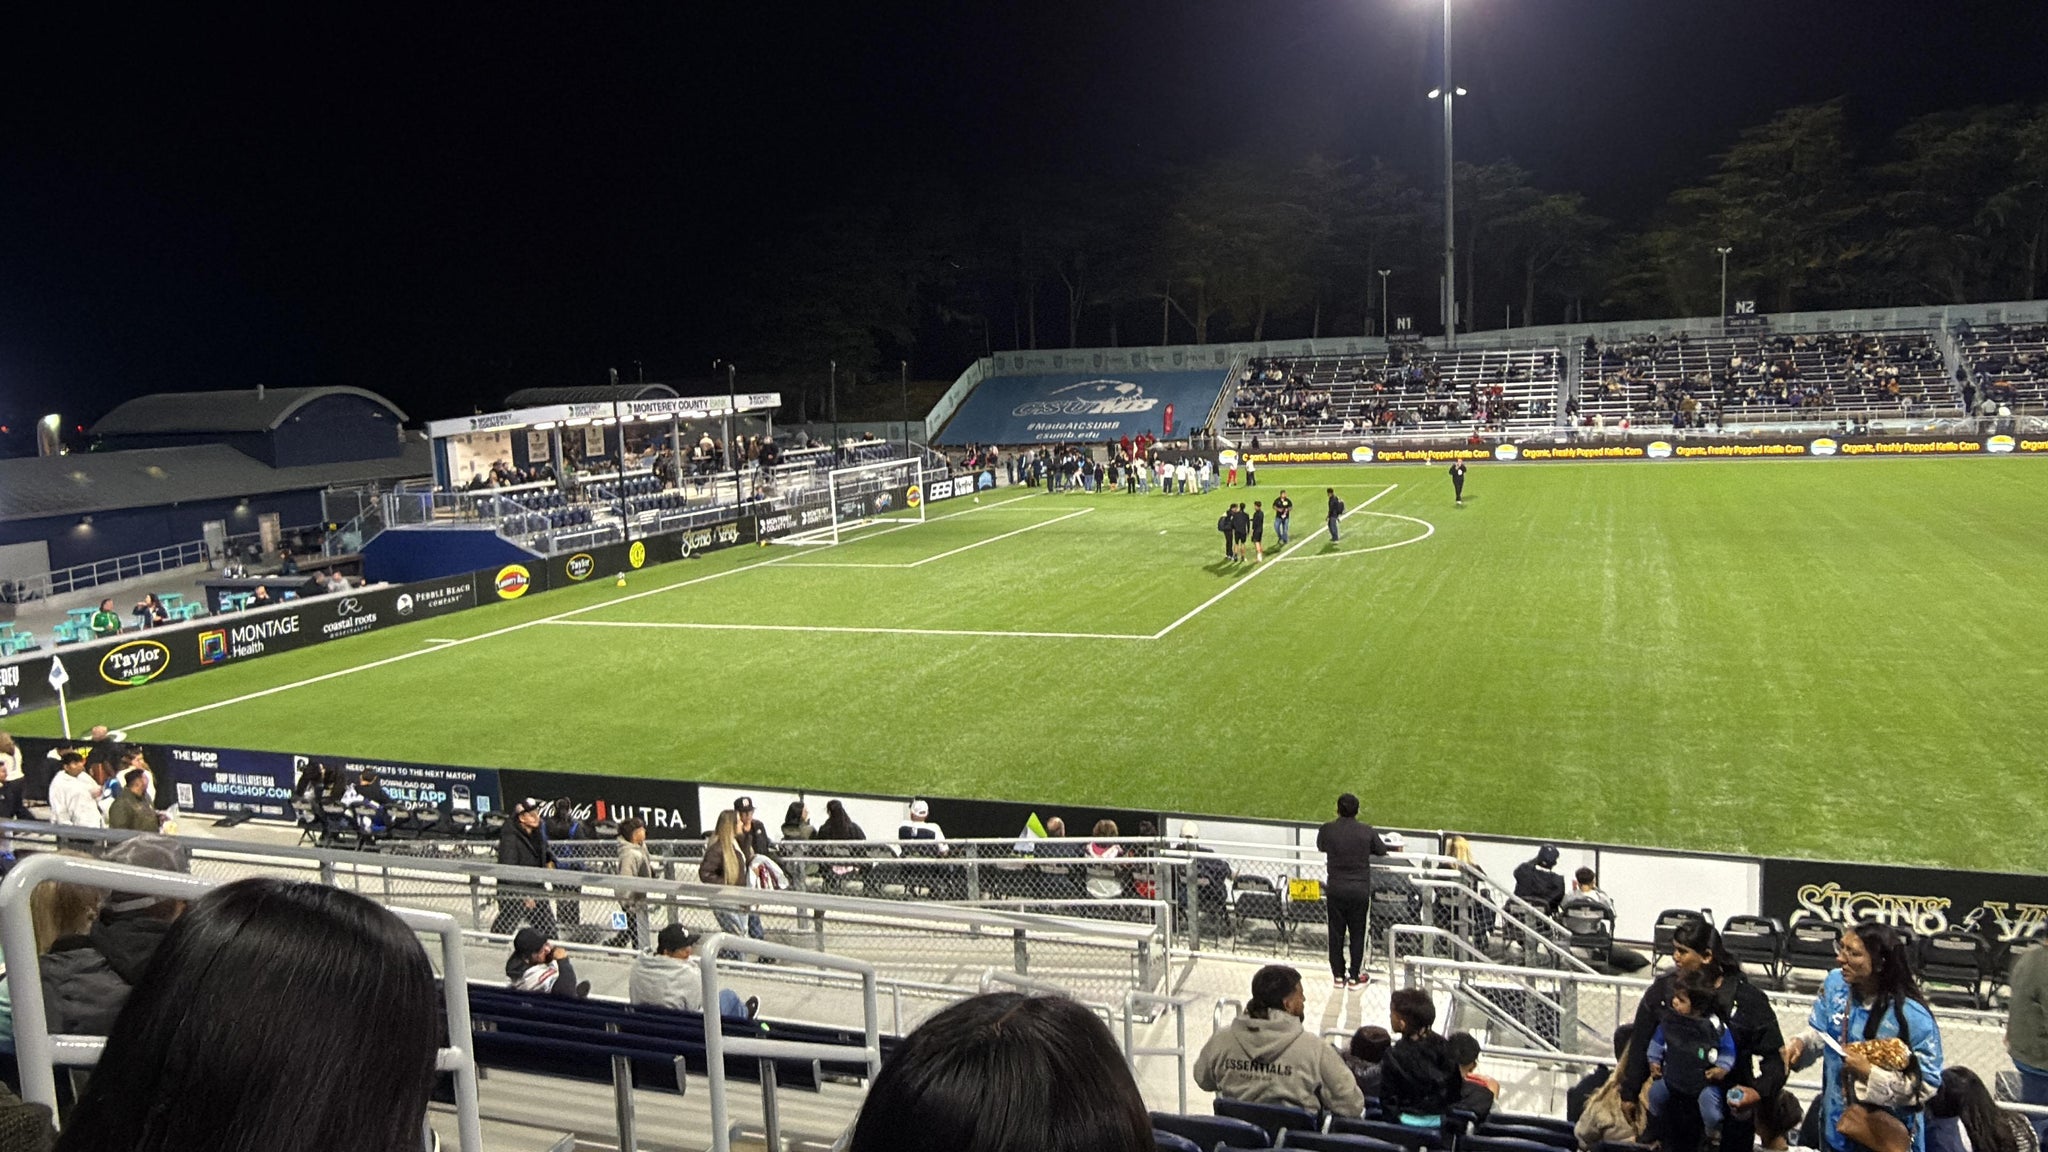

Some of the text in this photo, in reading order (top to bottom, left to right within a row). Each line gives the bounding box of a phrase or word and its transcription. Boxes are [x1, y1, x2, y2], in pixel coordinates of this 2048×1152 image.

[1736, 301, 1755, 314] N2
[1397, 317, 1411, 330] N1
[633, 401, 677, 413] MONTEREY
[678, 399, 708, 410] COUNTY
[1027, 421, 1120, 431] #MadeAtCSUMB
[1036, 431, 1100, 440] csumb.edu
[1576, 447, 1604, 457] Popped
[1624, 446, 1643, 456] Corn
[1734, 445, 1762, 455] Popped
[1785, 444, 1804, 453] Corn
[1904, 442, 1935, 452] Popped
[1959, 441, 1980, 451] Corn
[1290, 452, 1313, 461] Popped
[1332, 451, 1348, 460] Corn
[1428, 450, 1454, 460] Popped
[1473, 449, 1490, 458] Corn
[415, 583, 471, 602] PEBBLE BEACH
[323, 612, 377, 633] coastal roots
[231, 615, 299, 644] MONTAGE
[232, 640, 264, 658] Health
[110, 648, 161, 669] Taylor
[122, 665, 151, 677] FARMS
[173, 750, 218, 762] THE SHOP
[345, 763, 365, 771] NEED
[397, 767, 408, 775] TO
[409, 768, 423, 777] THE
[424, 769, 445, 778] NEXT
[445, 771, 477, 781] MATCH?
[380, 779, 435, 790] DOWNLOAD OUR
[420, 792, 447, 803] APP
[611, 804, 685, 829] ULTRA
[1225, 1058, 1292, 1076] ESSENTIALS
